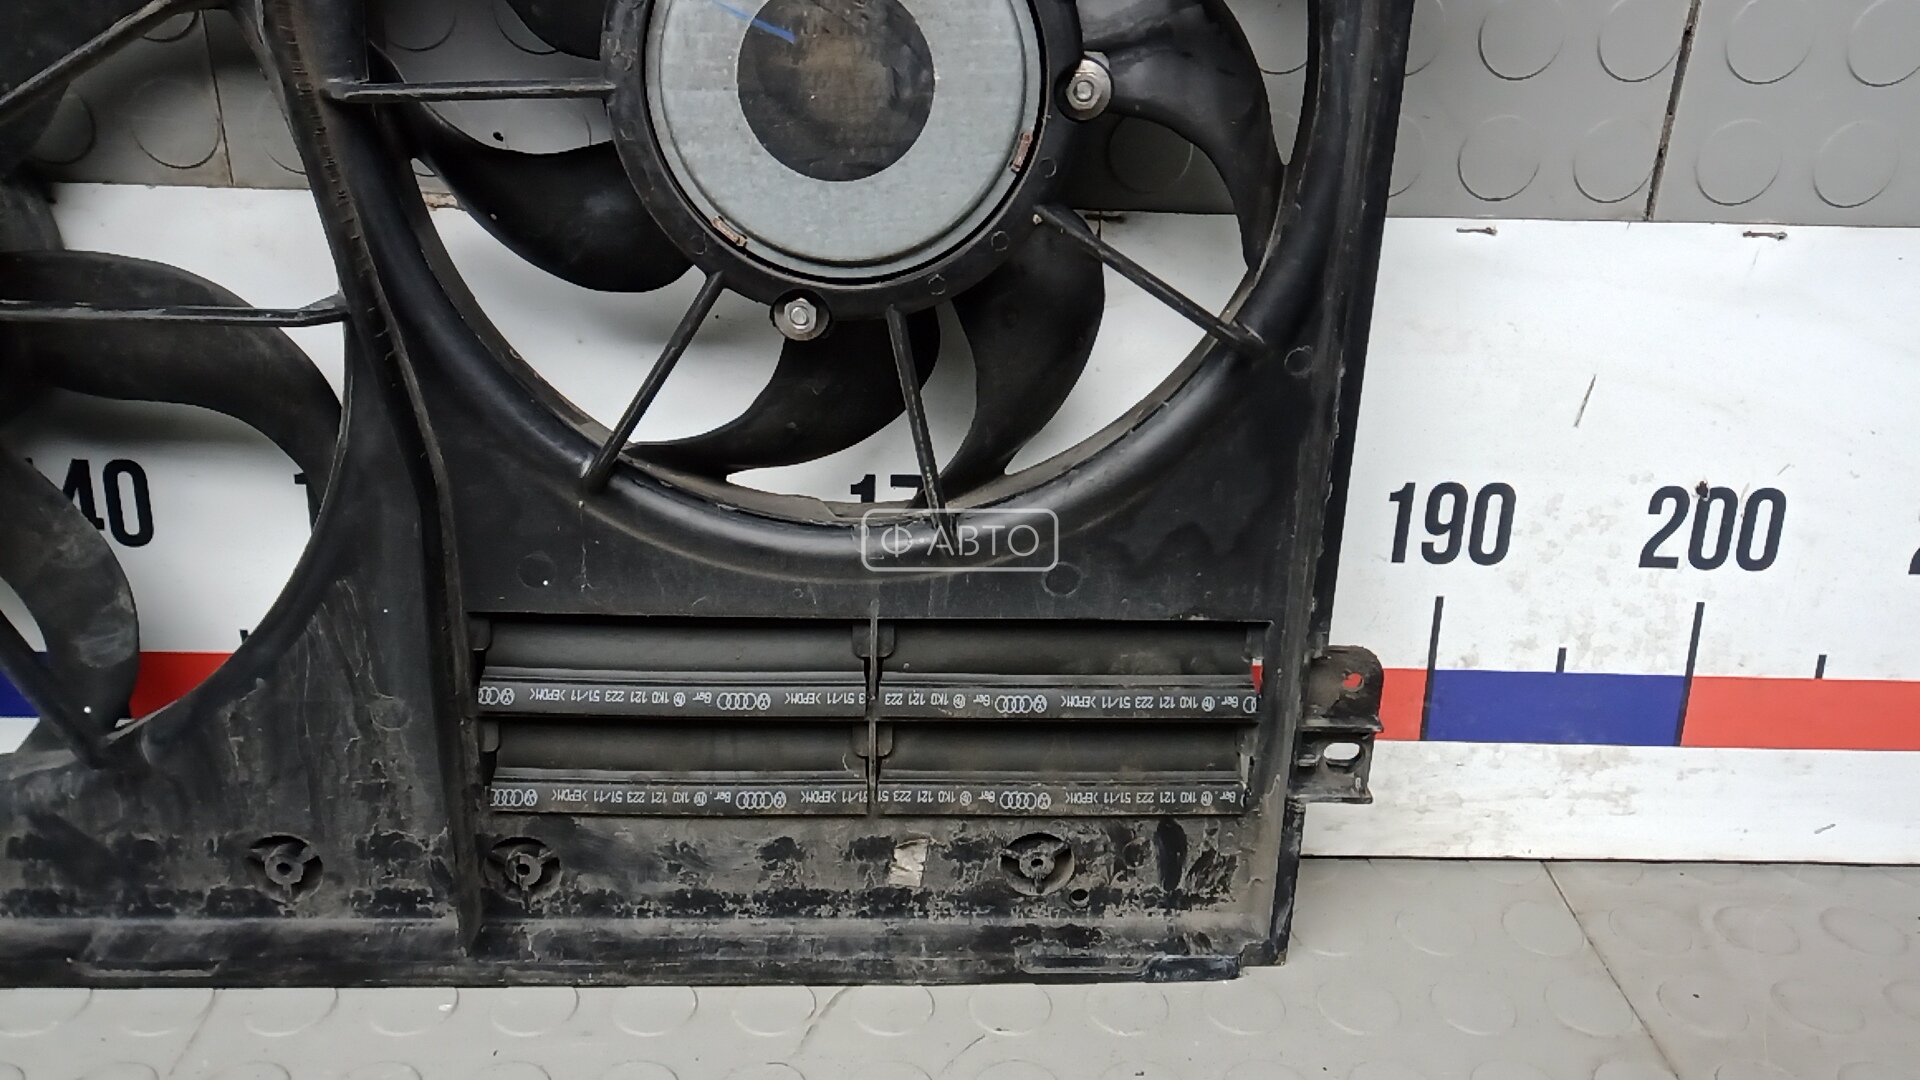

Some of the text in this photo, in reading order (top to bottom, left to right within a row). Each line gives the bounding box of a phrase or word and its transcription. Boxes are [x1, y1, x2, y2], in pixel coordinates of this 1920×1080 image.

[27, 457, 154, 547] 40
[1388, 482, 1517, 565] 190
[1638, 484, 1787, 571] 200
[570, 689, 600, 702] 51/11
[605, 690, 624, 702] 223
[630, 691, 647, 703] 121
[884, 693, 903, 706] 223
[908, 693, 926, 706] 121
[1102, 694, 1131, 708] 51/11
[1135, 695, 1154, 708] 223
[1159, 695, 1176, 708] 121
[593, 790, 623, 803] 51/11
[626, 791, 645, 803] 223
[652, 791, 667, 803] 121
[893, 791, 912, 803] 223
[917, 791, 934, 803] 121
[1103, 791, 1131, 803] 51/11
[1136, 791, 1154, 803] 223
[1159, 790, 1176, 803] 121
